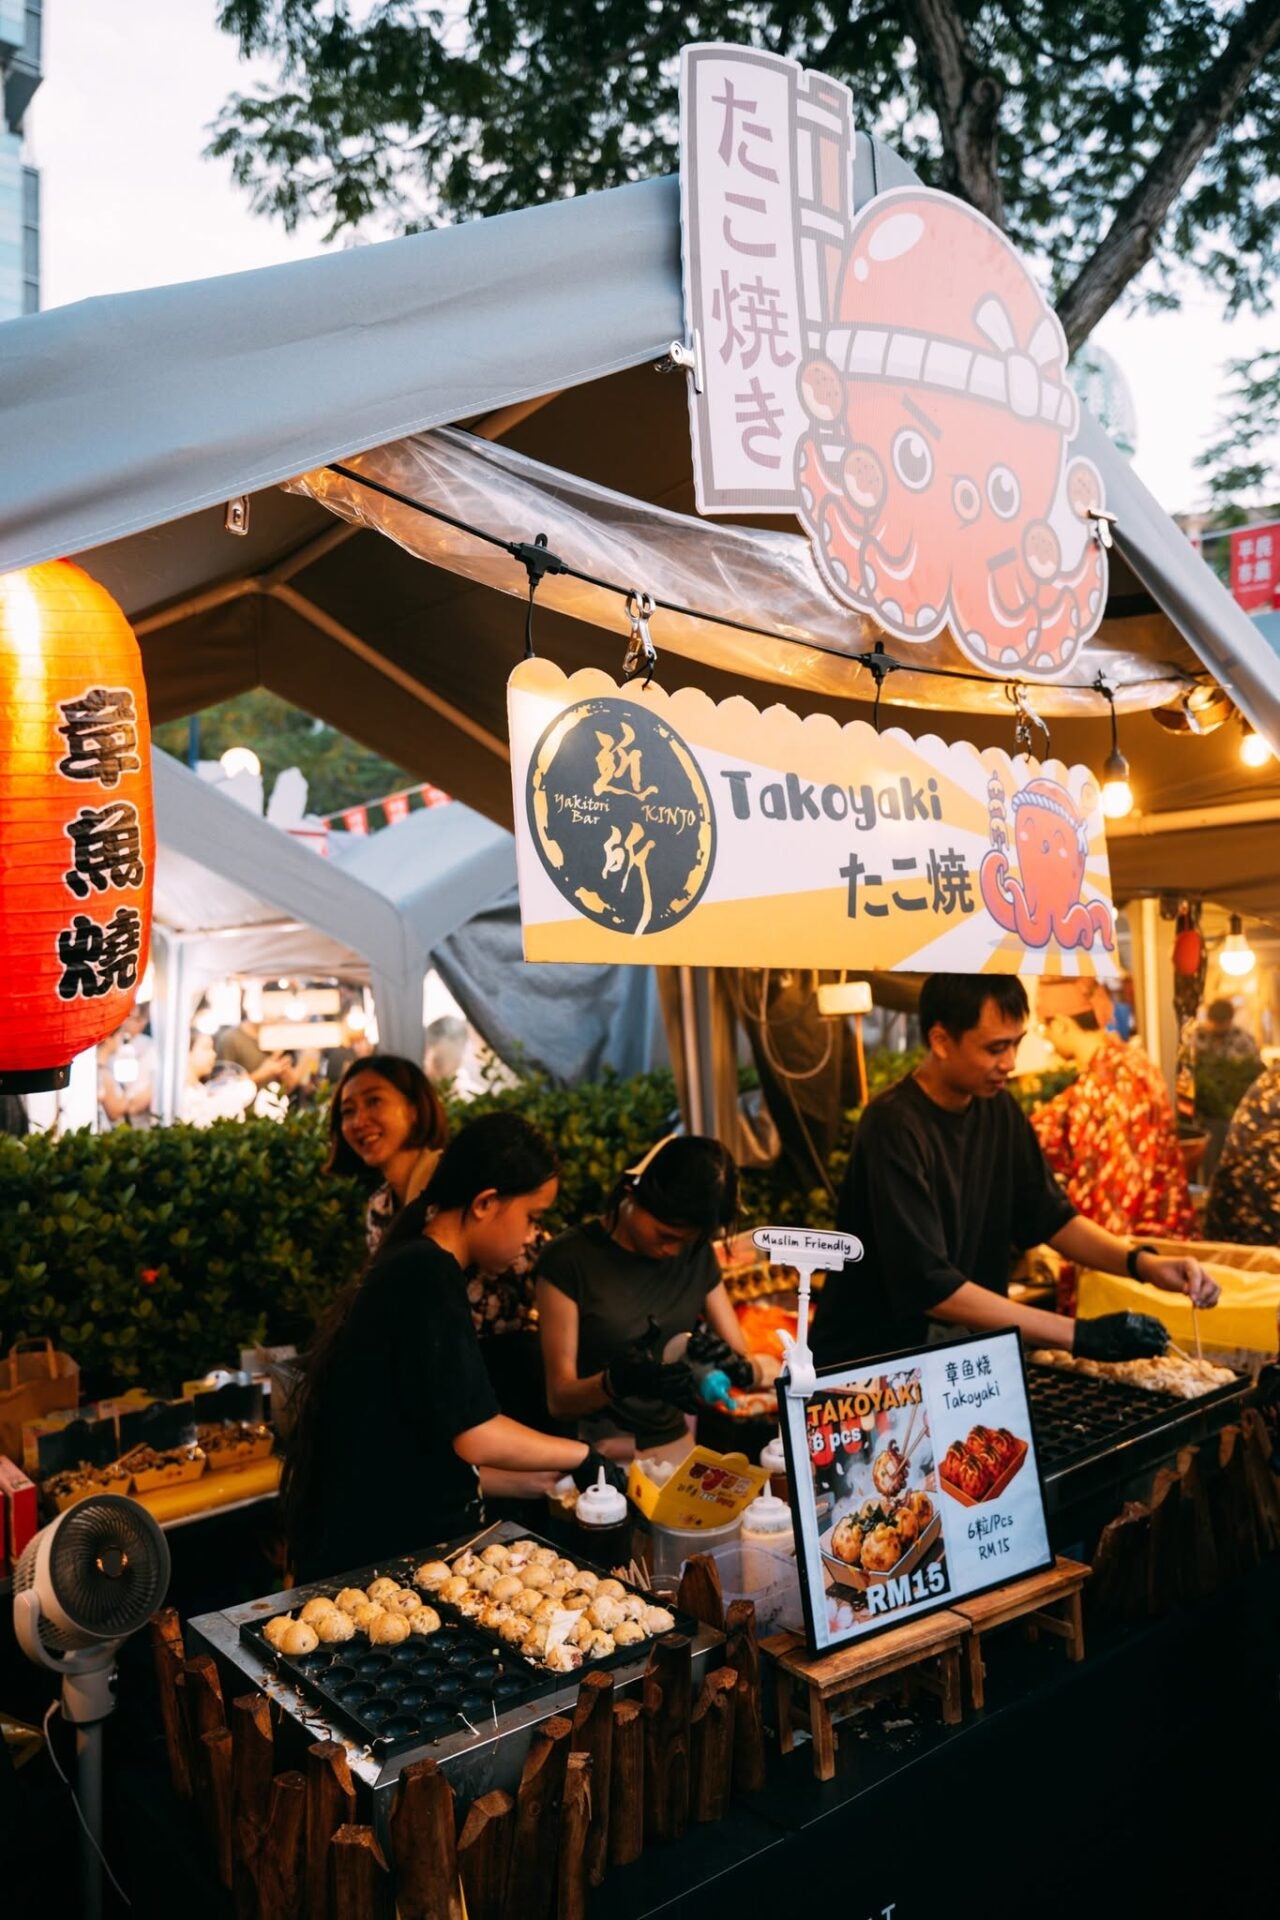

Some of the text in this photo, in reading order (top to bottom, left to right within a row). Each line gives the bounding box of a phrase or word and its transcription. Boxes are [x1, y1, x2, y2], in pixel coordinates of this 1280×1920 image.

[711, 77, 796, 470] たこ焼き
[554, 793, 610, 814] Yakitori
[571, 809, 601, 825] Bar
[720, 770, 943, 831] Takoyaki
[641, 804, 696, 835] KINJO
[58, 687, 144, 999] 章魚燒
[839, 847, 975, 919] たこ焼
[761, 1233, 851, 1255] Muslim Friendly
[944, 1354, 993, 1387] 章鱼烧
[806, 1382, 923, 1428] TAKOYAKI
[942, 1380, 1000, 1410] Takoyaki
[812, 1427, 862, 1452] 6 pcs
[866, 1561, 946, 1616] RM15
